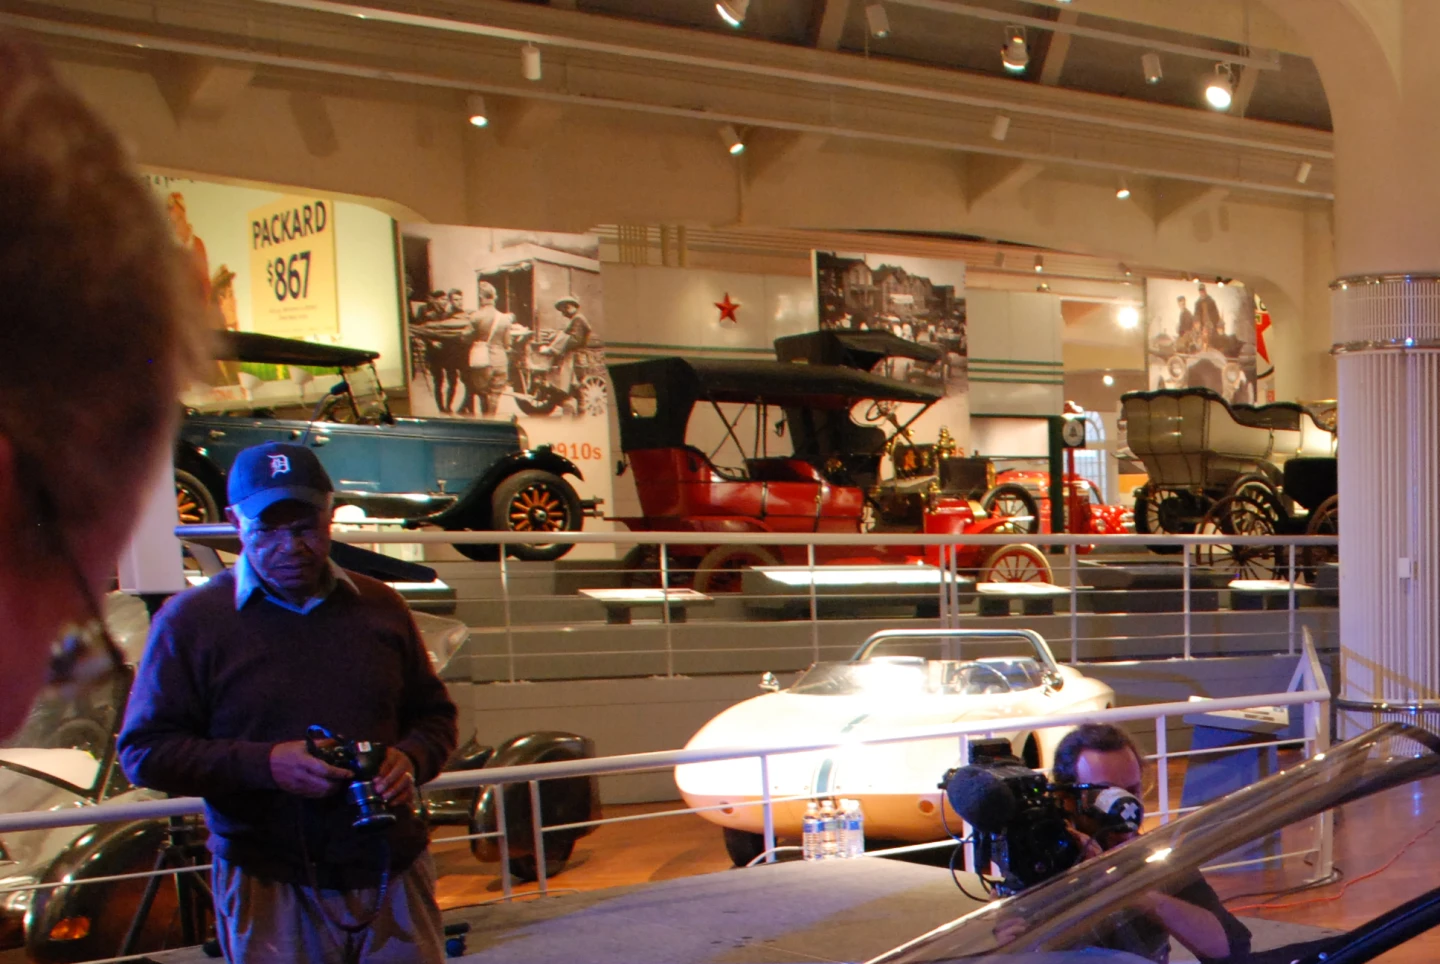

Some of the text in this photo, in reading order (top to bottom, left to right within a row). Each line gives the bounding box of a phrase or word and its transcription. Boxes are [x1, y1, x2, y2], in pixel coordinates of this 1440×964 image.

[252, 200, 327, 250] PACKARD
[266, 250, 311, 301] $867
[266, 454, 291, 478] D
[551, 442, 602, 460] 910s
